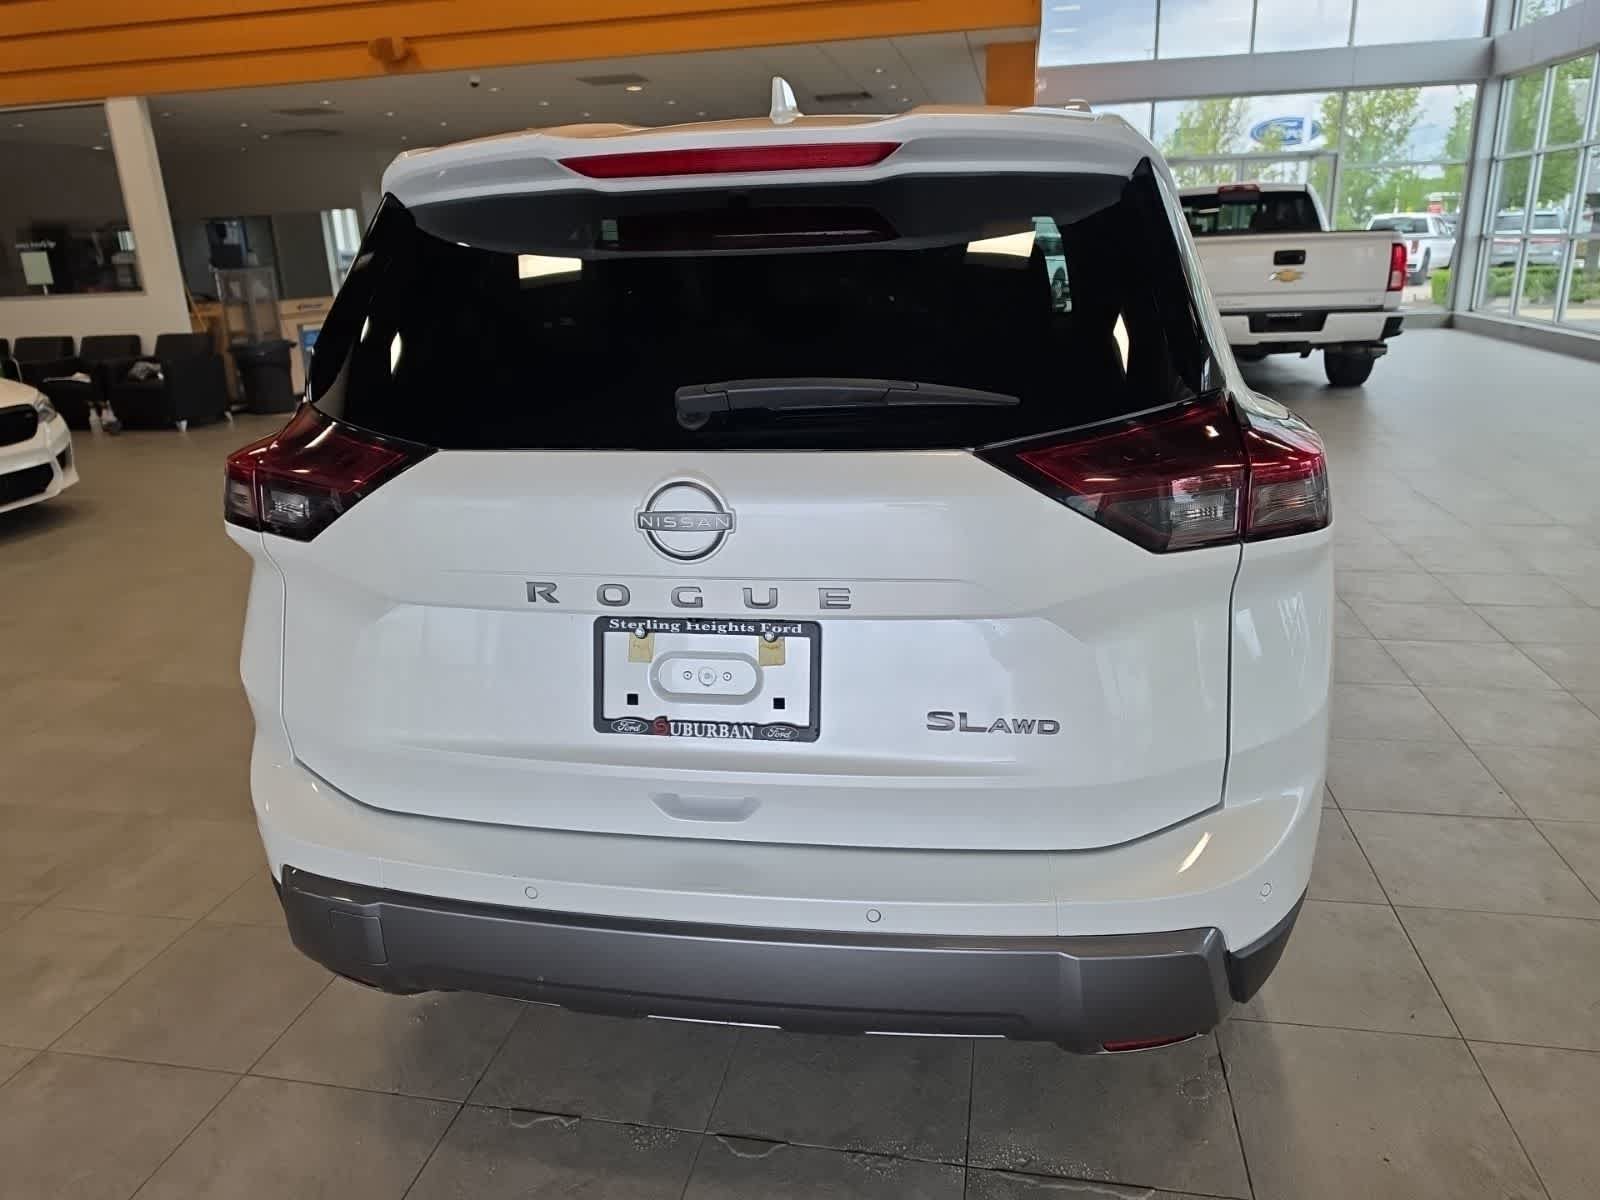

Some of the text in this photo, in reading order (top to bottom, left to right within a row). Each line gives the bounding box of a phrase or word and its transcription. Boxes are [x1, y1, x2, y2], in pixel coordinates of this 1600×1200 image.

[638, 514, 732, 529] NISSAN
[525, 580, 852, 610] ROGUE
[609, 618, 802, 634] Sterling Heights Ford
[615, 716, 793, 739] Ford SUBURBAN Ford
